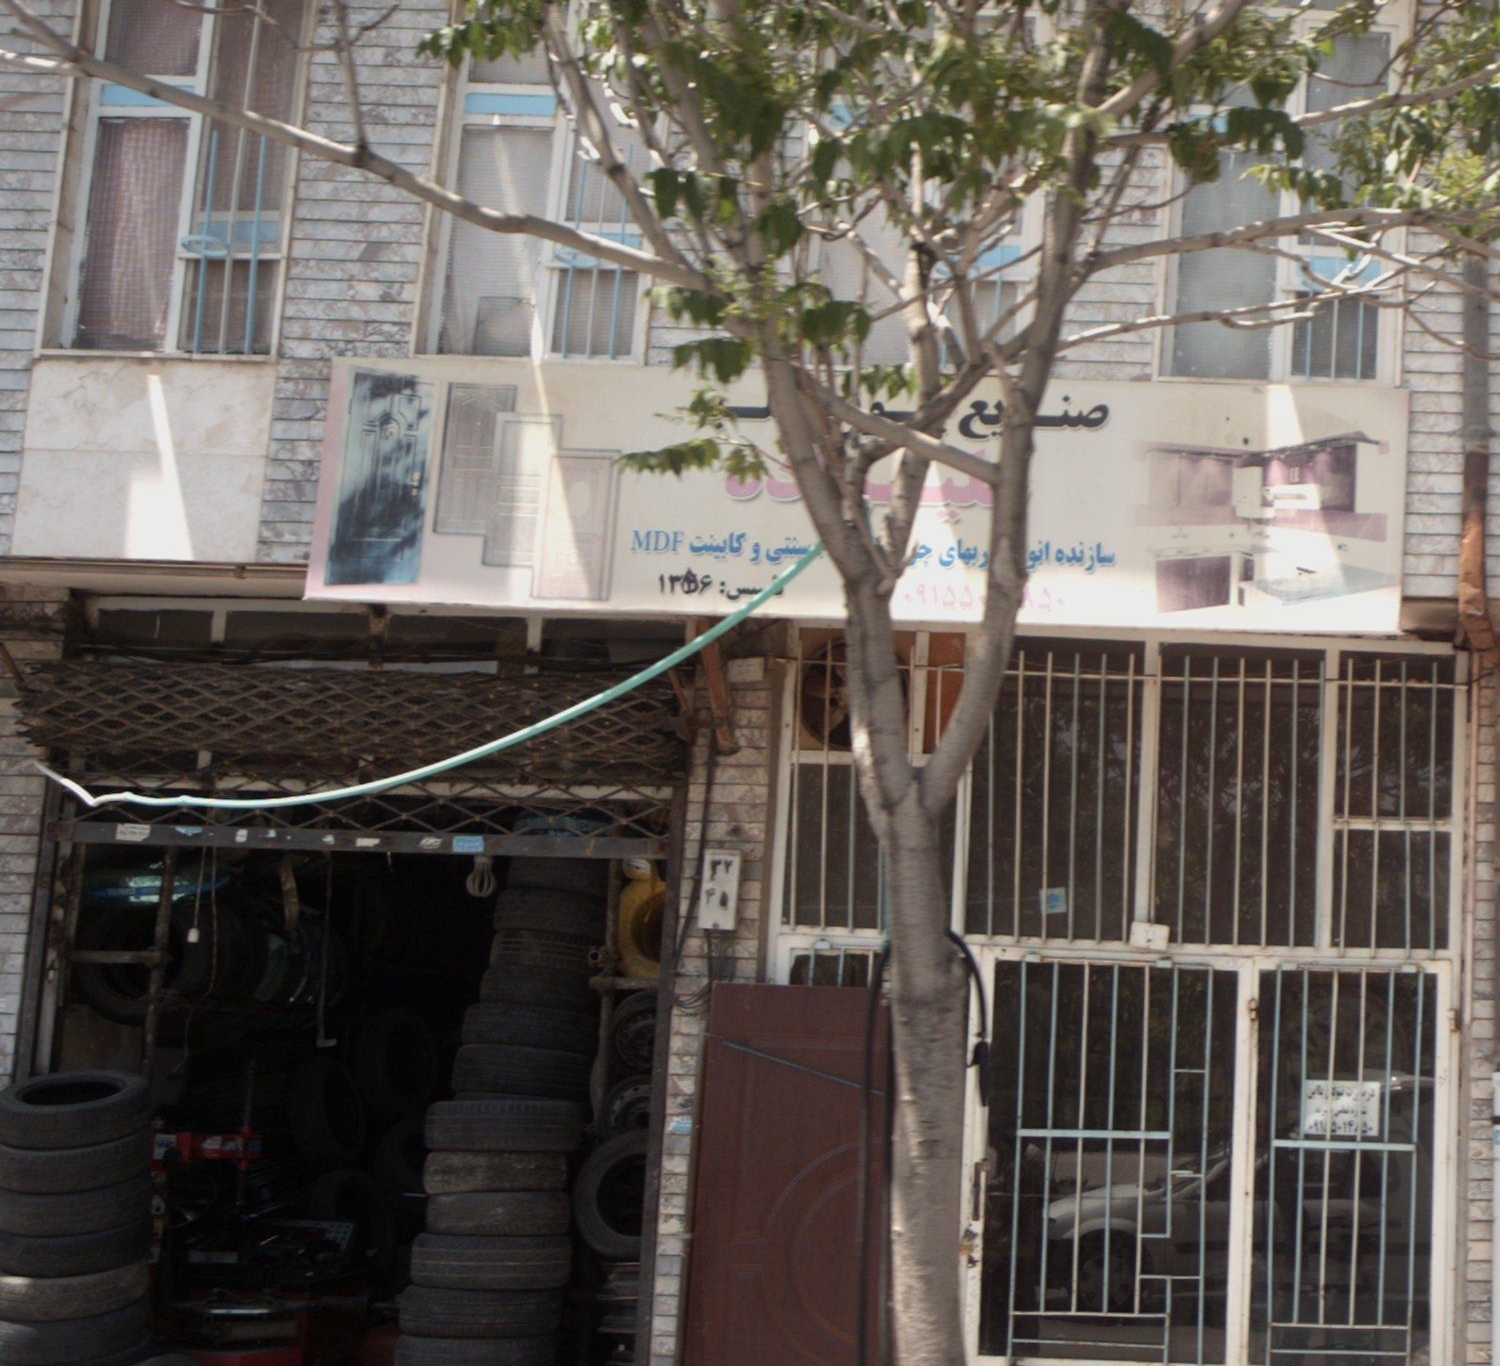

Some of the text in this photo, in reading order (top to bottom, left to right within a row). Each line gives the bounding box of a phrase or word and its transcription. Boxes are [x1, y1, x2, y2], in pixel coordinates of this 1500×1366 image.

[957, 394, 1110, 440] صنیع
[631, 529, 684, 554] MDF
[688, 531, 747, 560] کابینت
[938, 537, 990, 569] ربهای
[1055, 540, 1116, 572] سازنده
